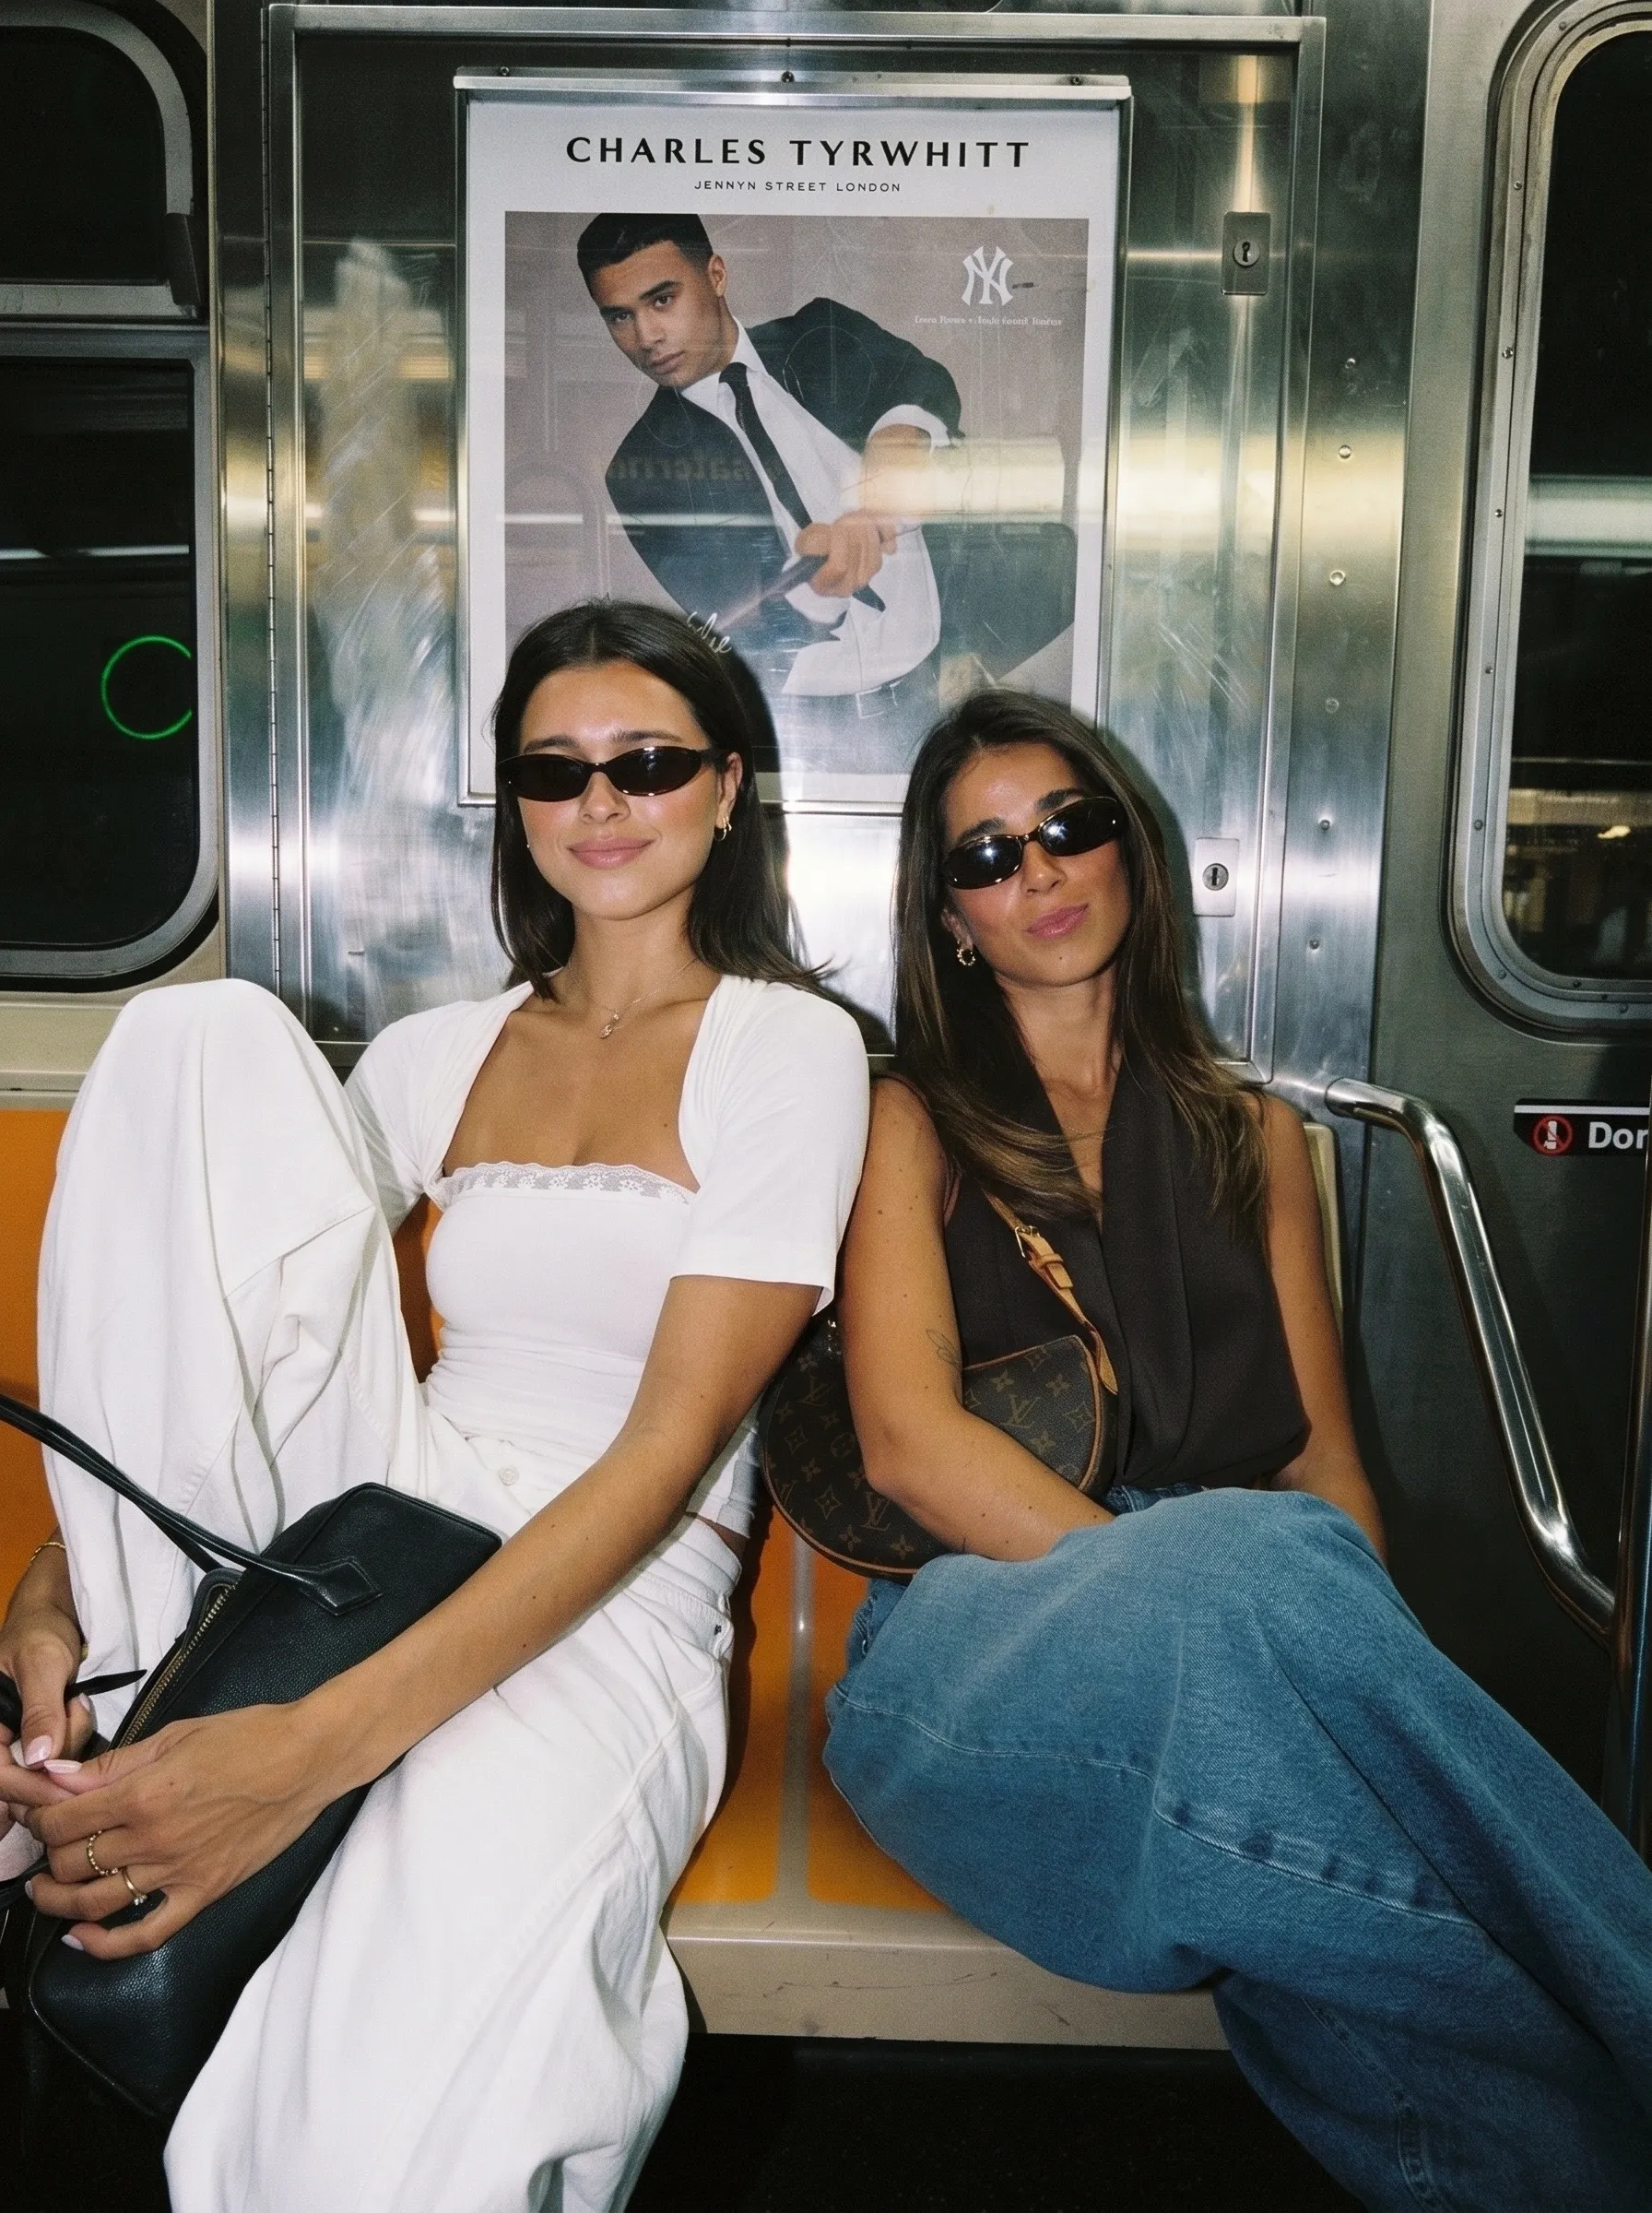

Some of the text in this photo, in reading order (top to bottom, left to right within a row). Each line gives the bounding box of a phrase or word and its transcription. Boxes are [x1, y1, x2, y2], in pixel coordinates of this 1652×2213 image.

[566, 136, 1029, 168] CHARLES TYRWHITT
[694, 181, 900, 193] JENNYN STREET LONDON
[962, 246, 1014, 306] NY
